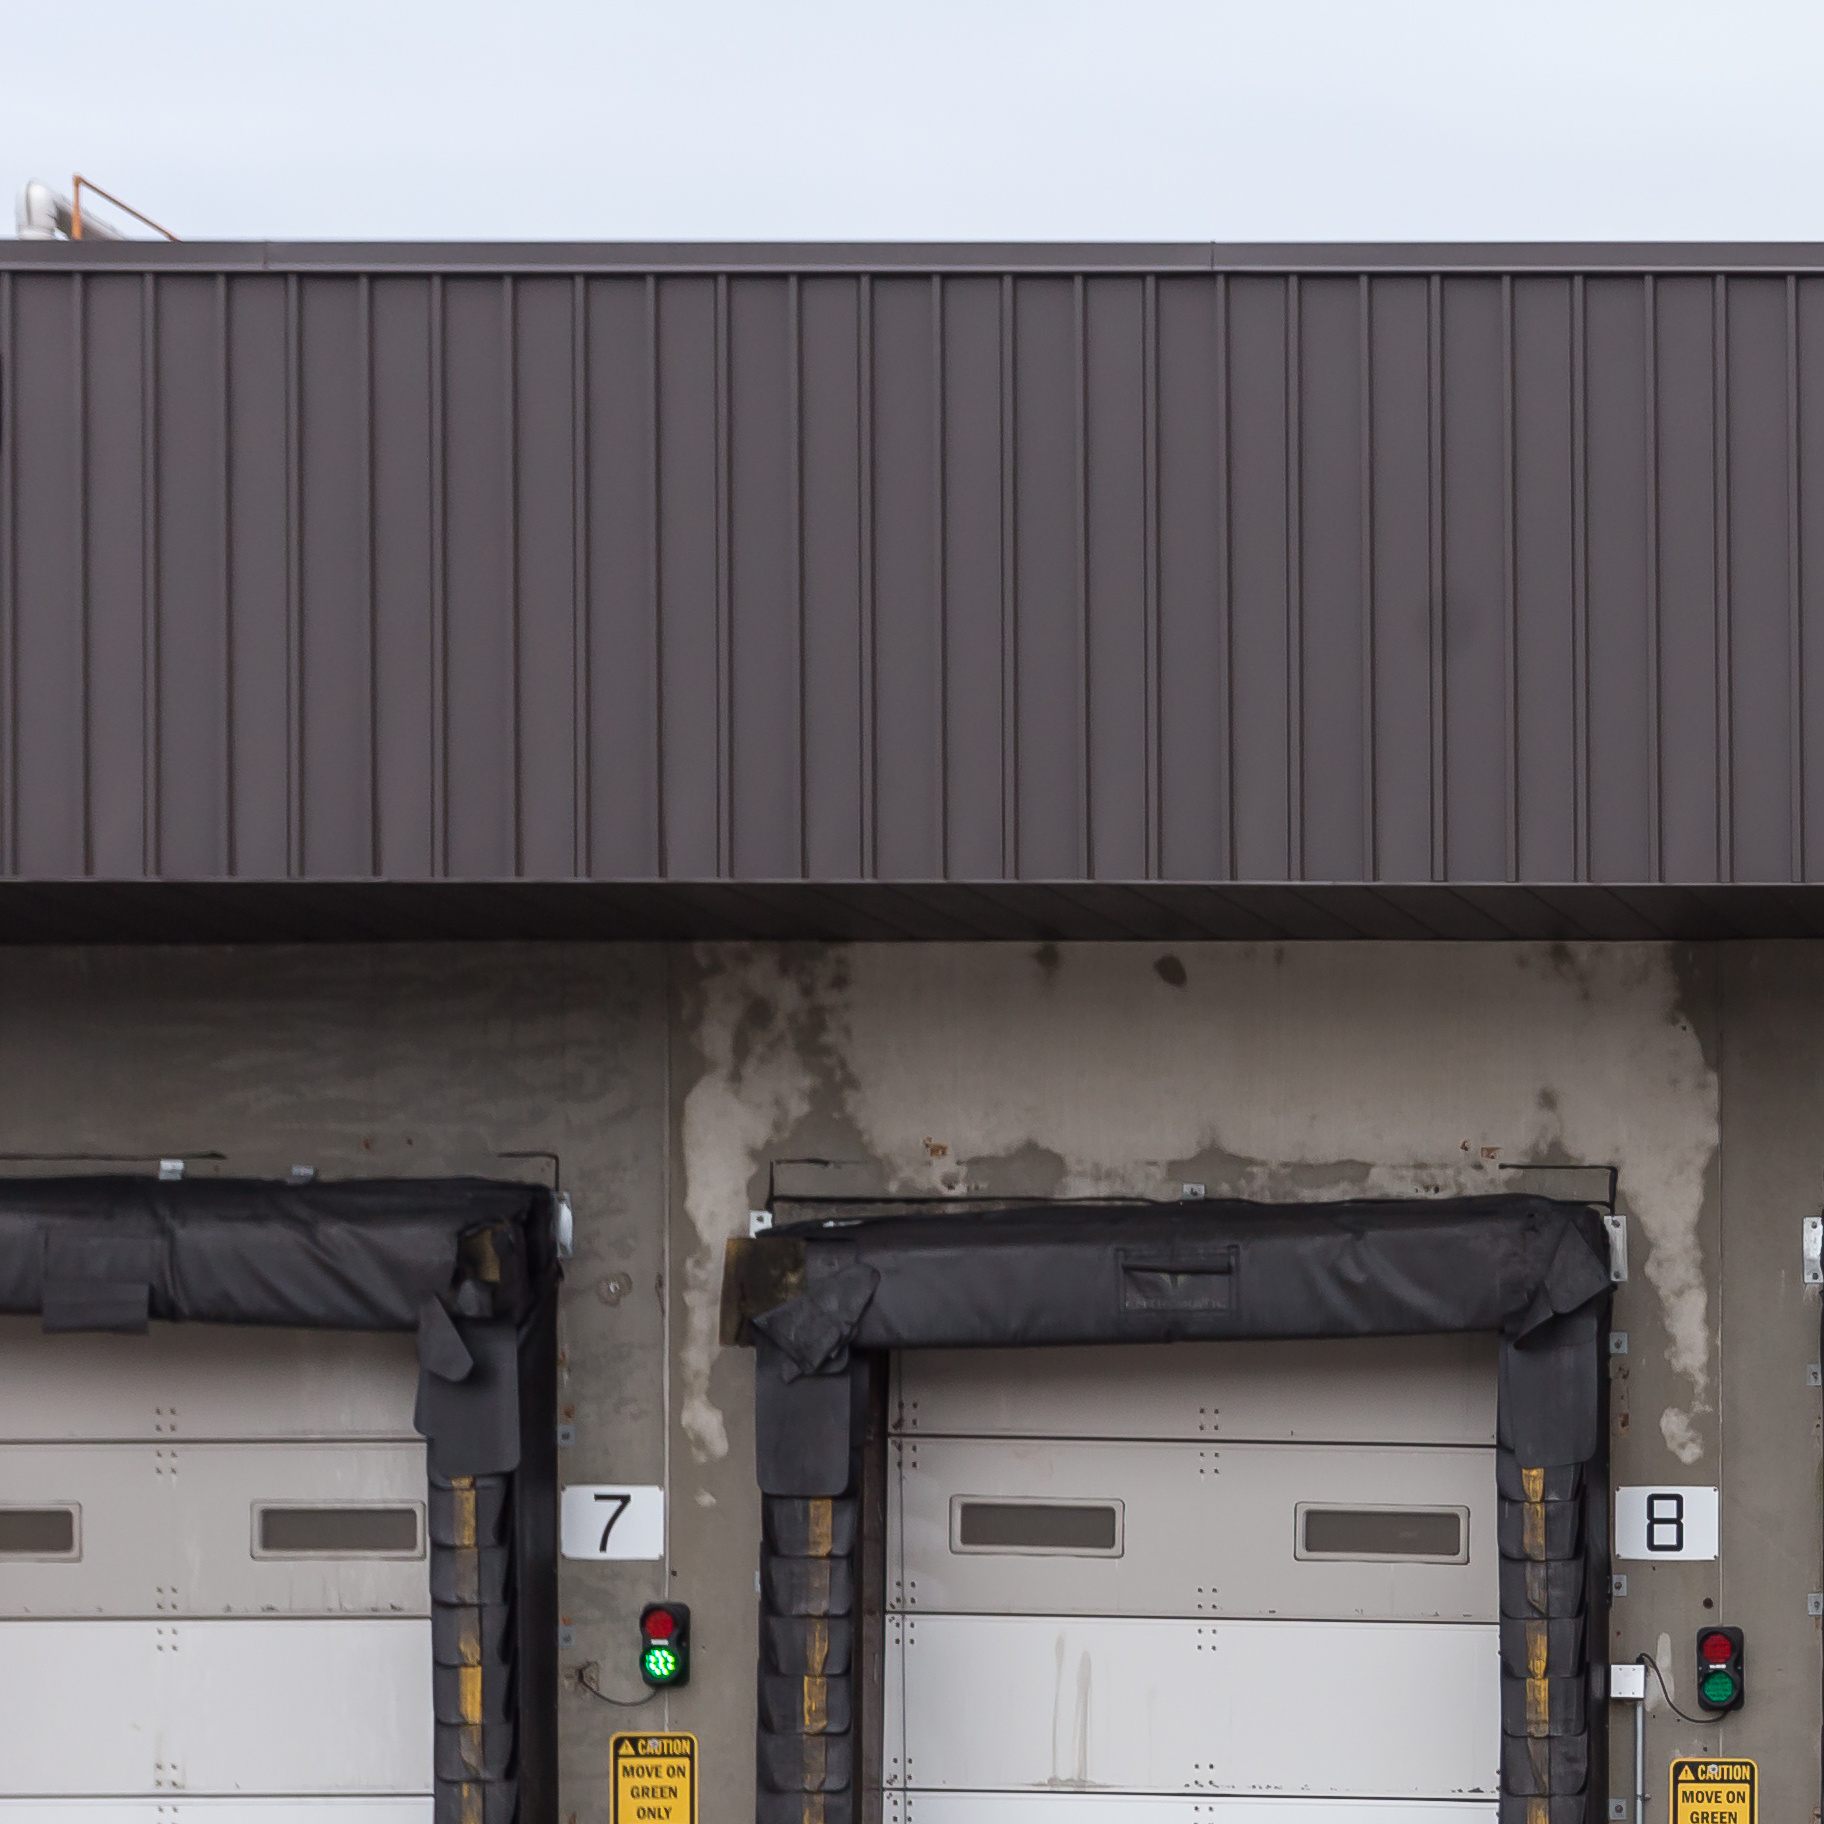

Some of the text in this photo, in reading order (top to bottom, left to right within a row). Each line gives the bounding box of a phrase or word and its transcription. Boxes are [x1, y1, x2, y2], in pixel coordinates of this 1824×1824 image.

[594, 1494, 630, 1552] 7
[1646, 1494, 1683, 1551] 8
[623, 1765, 685, 1778] MOVE ON
[631, 1786, 677, 1798] GREEN
[1682, 1791, 1745, 1803] MOVE ON
[637, 1807, 671, 1820] ONLY
[1690, 1811, 1737, 1824] GREEN
